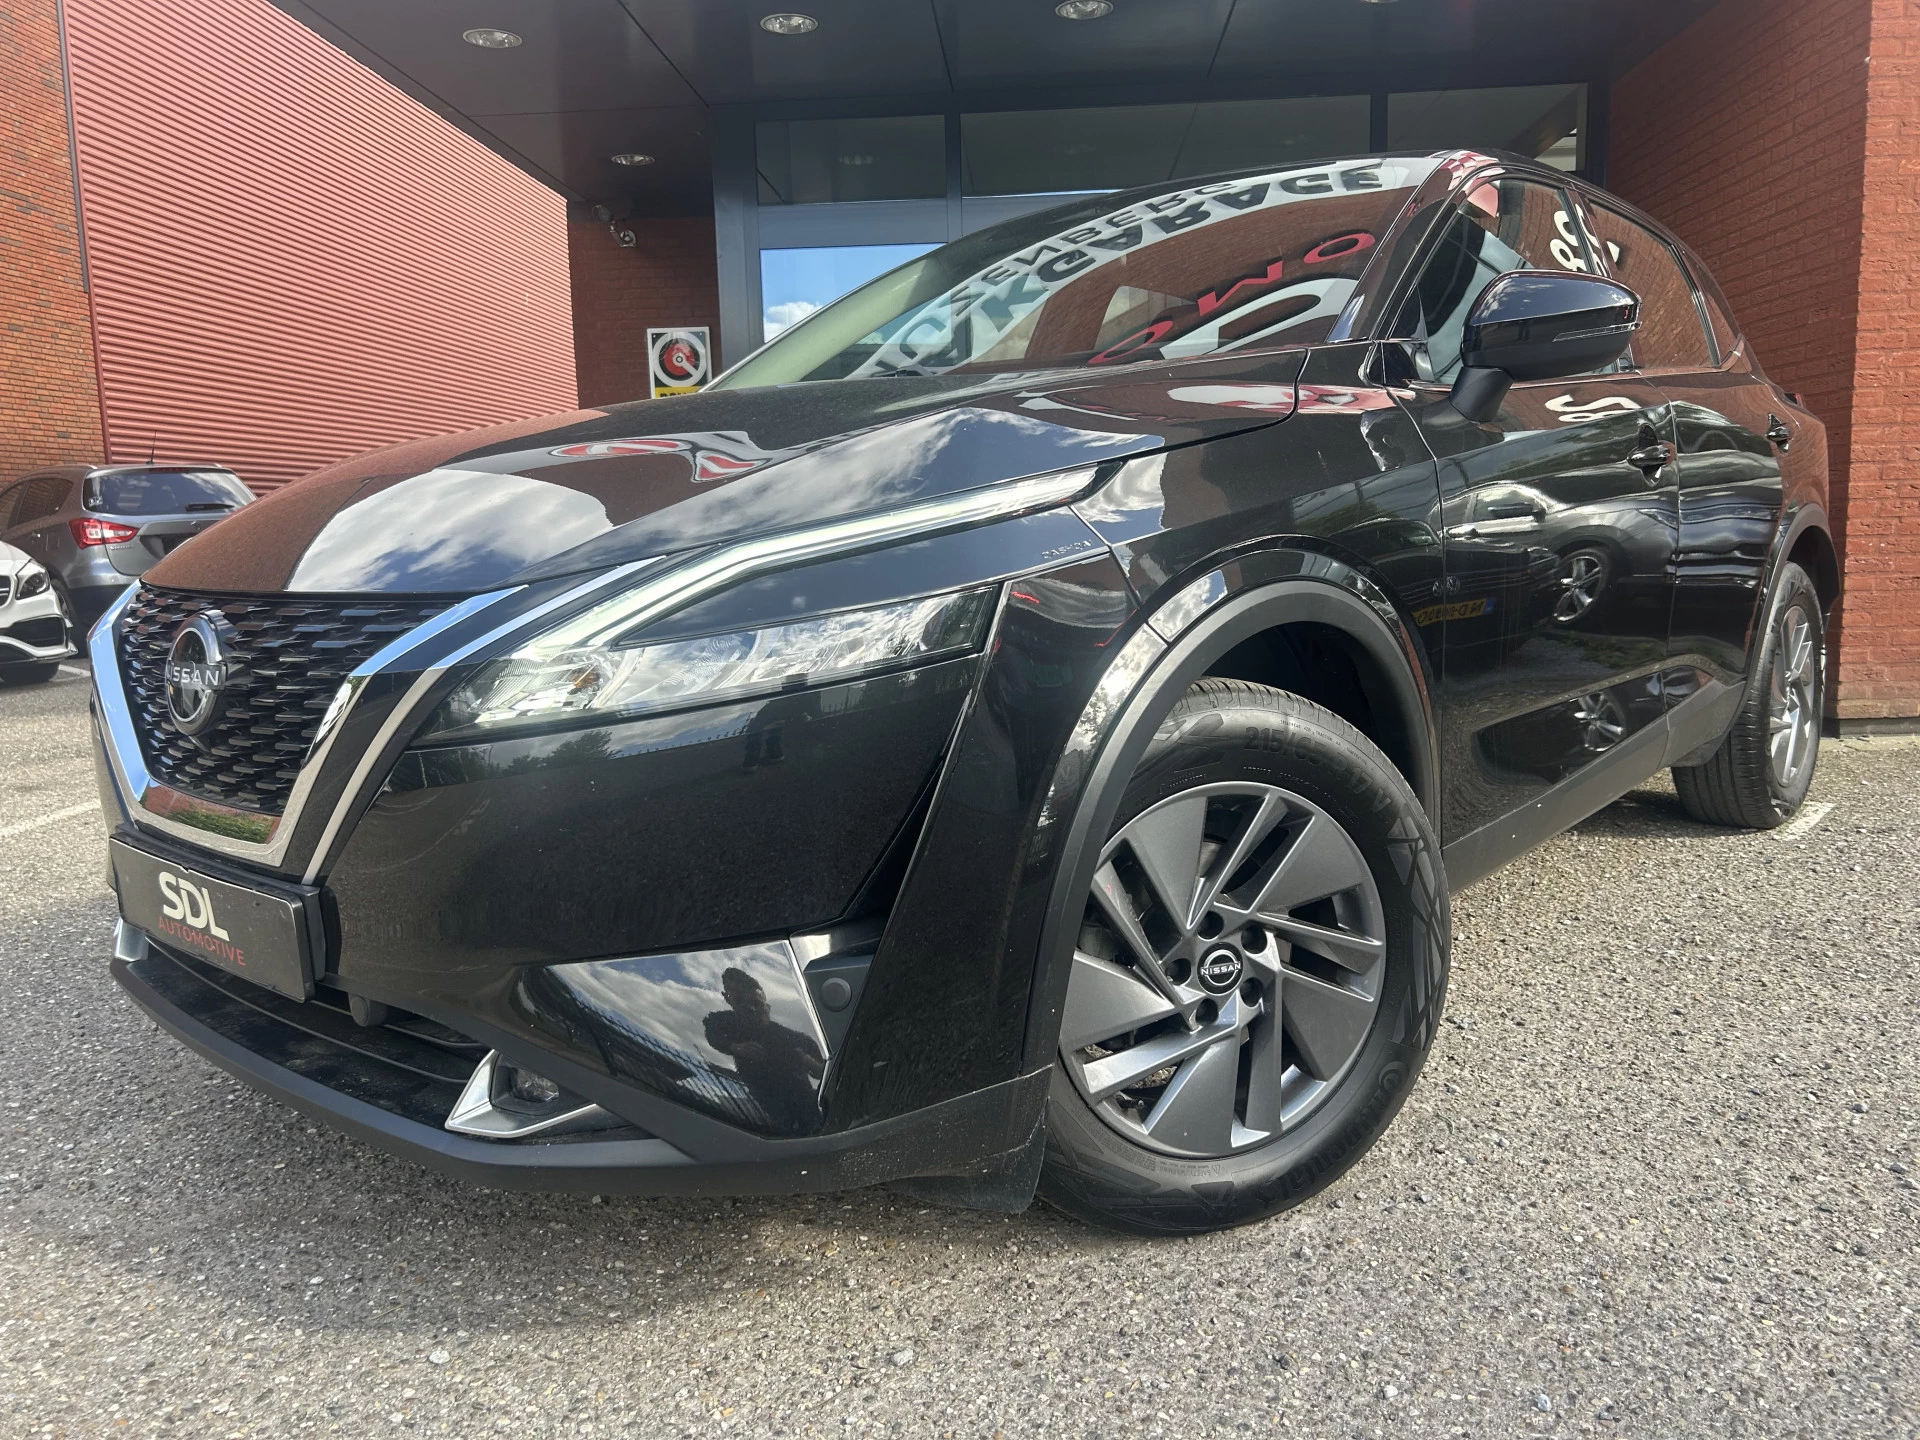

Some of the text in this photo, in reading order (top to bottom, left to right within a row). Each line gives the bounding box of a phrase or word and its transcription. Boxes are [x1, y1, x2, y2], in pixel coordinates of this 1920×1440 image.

[166, 660, 220, 686] ISSAN
[158, 871, 230, 942] SDL
[158, 915, 247, 967] AUTOMOTIVE
[1201, 962, 1241, 975] NISSAN
